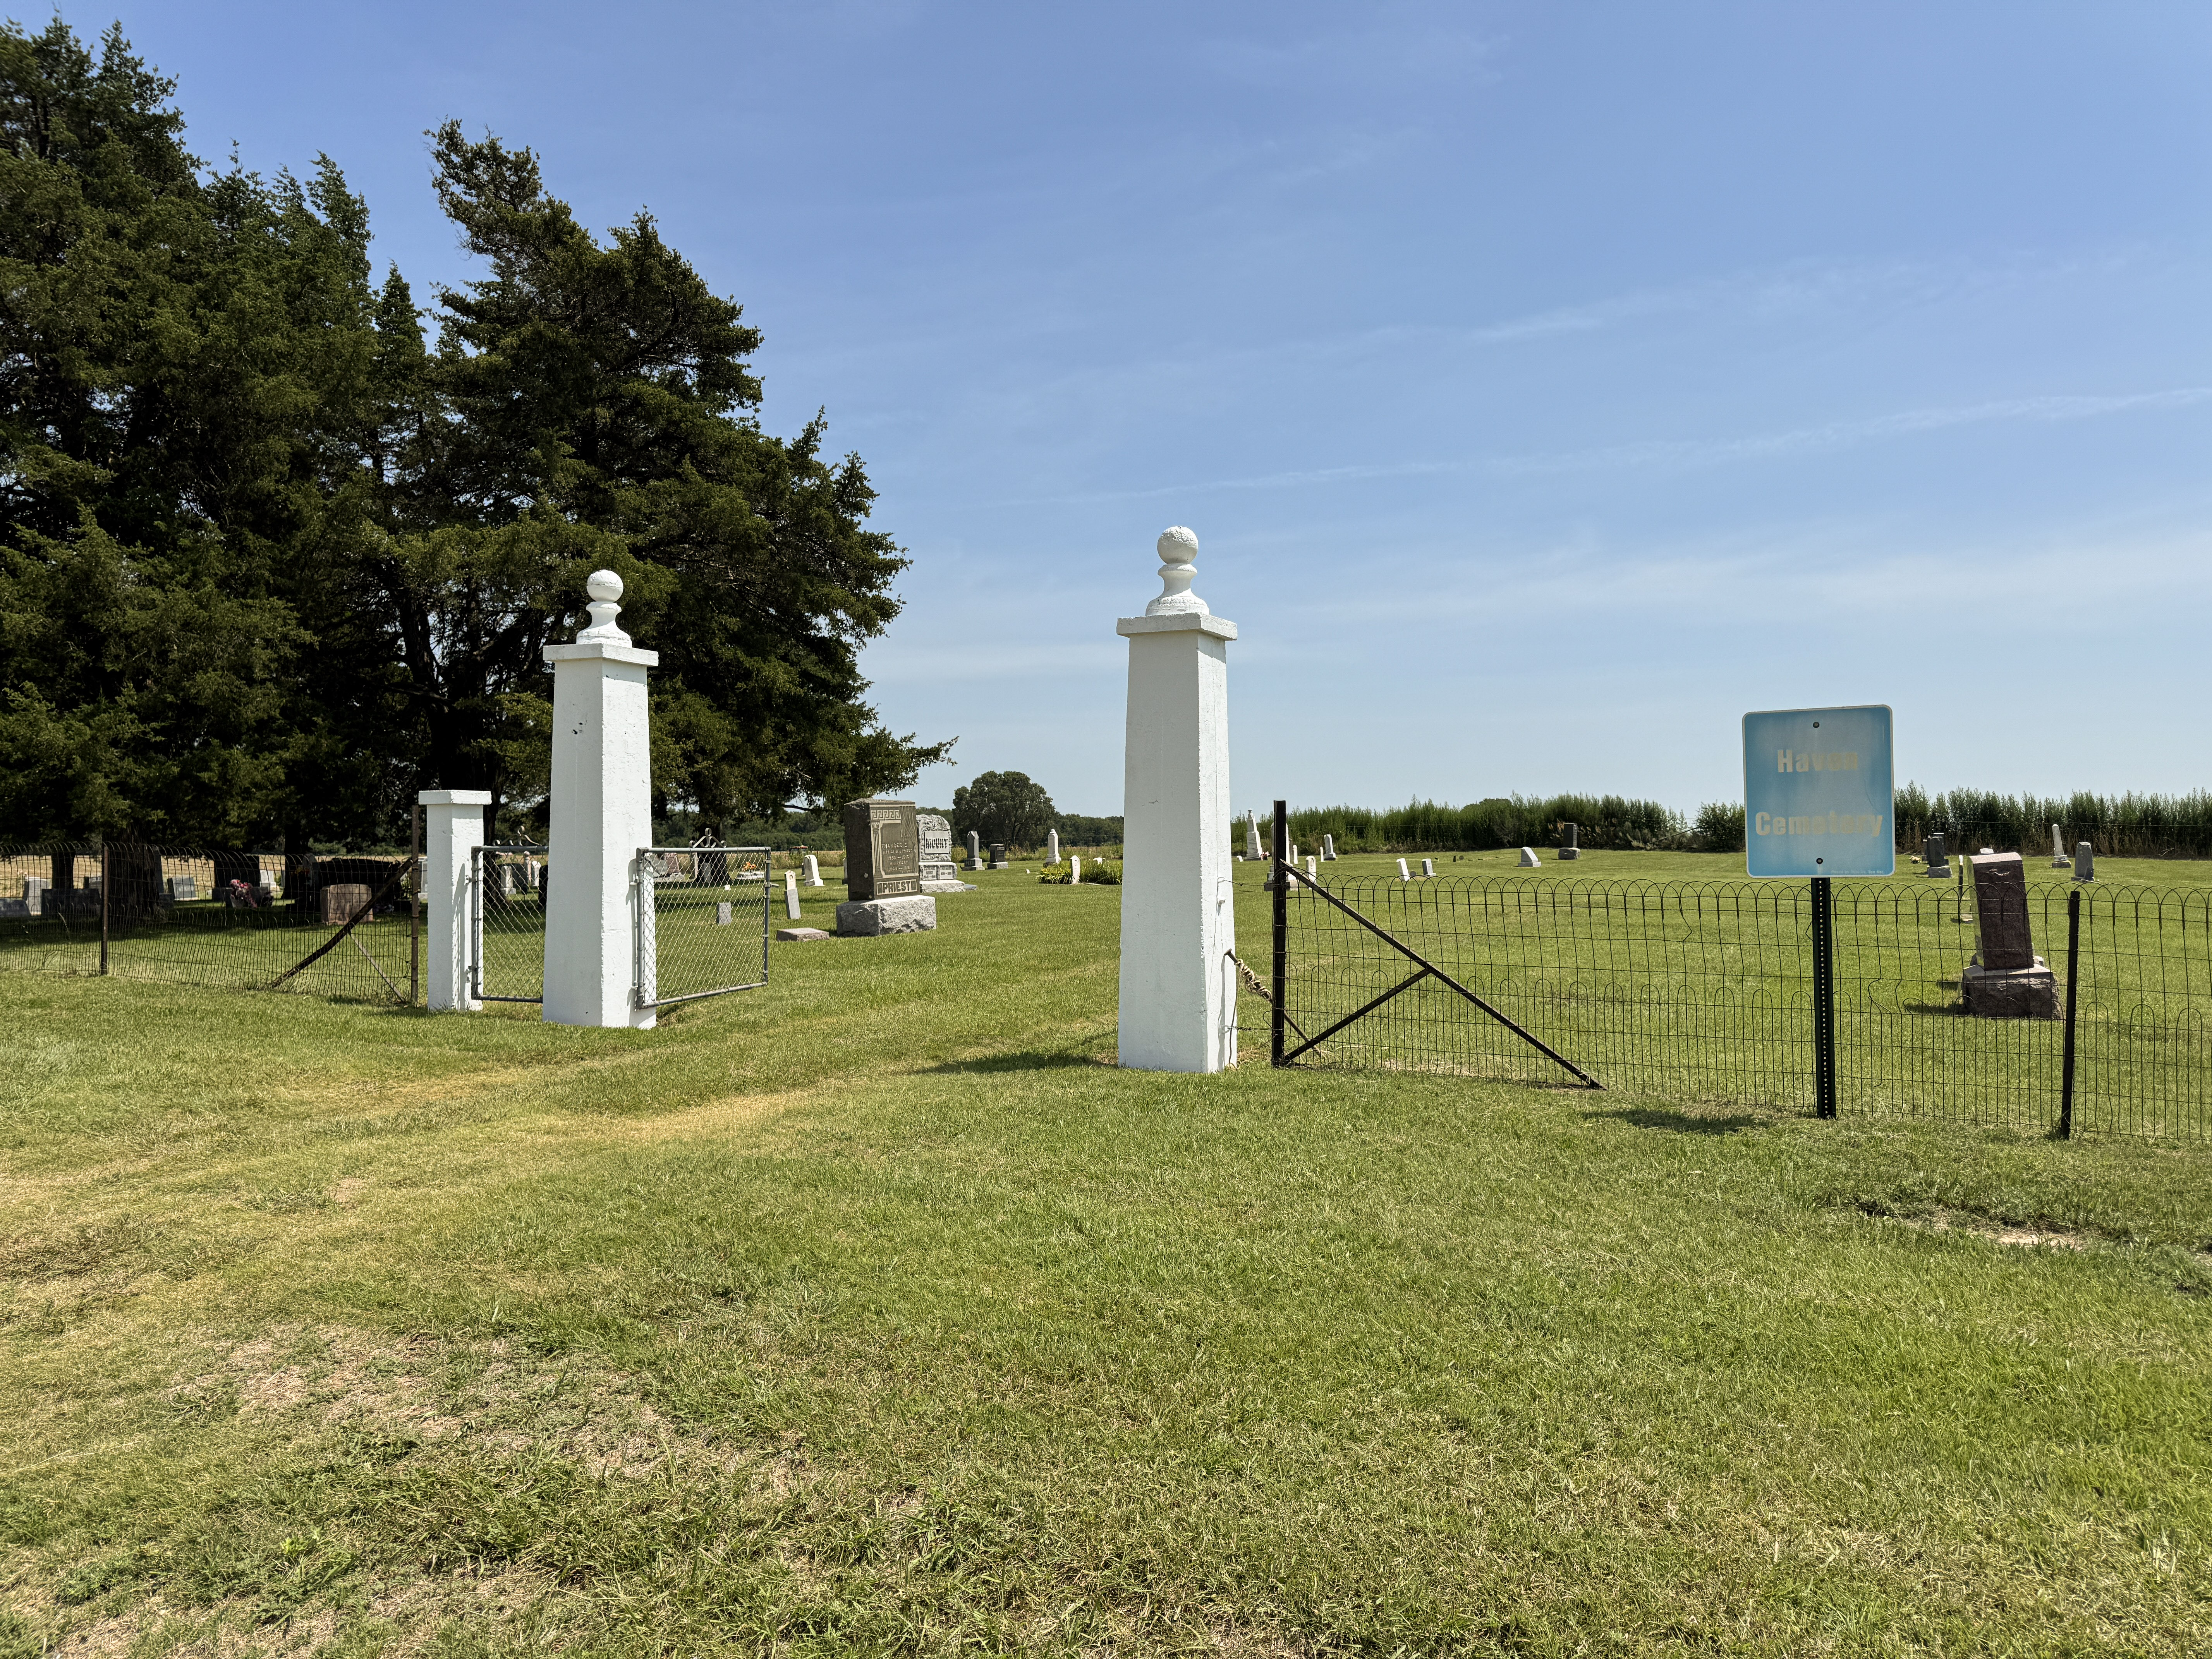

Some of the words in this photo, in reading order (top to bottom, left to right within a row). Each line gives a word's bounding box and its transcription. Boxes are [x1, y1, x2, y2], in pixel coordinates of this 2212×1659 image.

[1778, 749, 1858, 773] Haven
[1755, 811, 1883, 837] Cemetery
[926, 838, 948, 849] MOUNT
[883, 881, 910, 893] PRIEST
